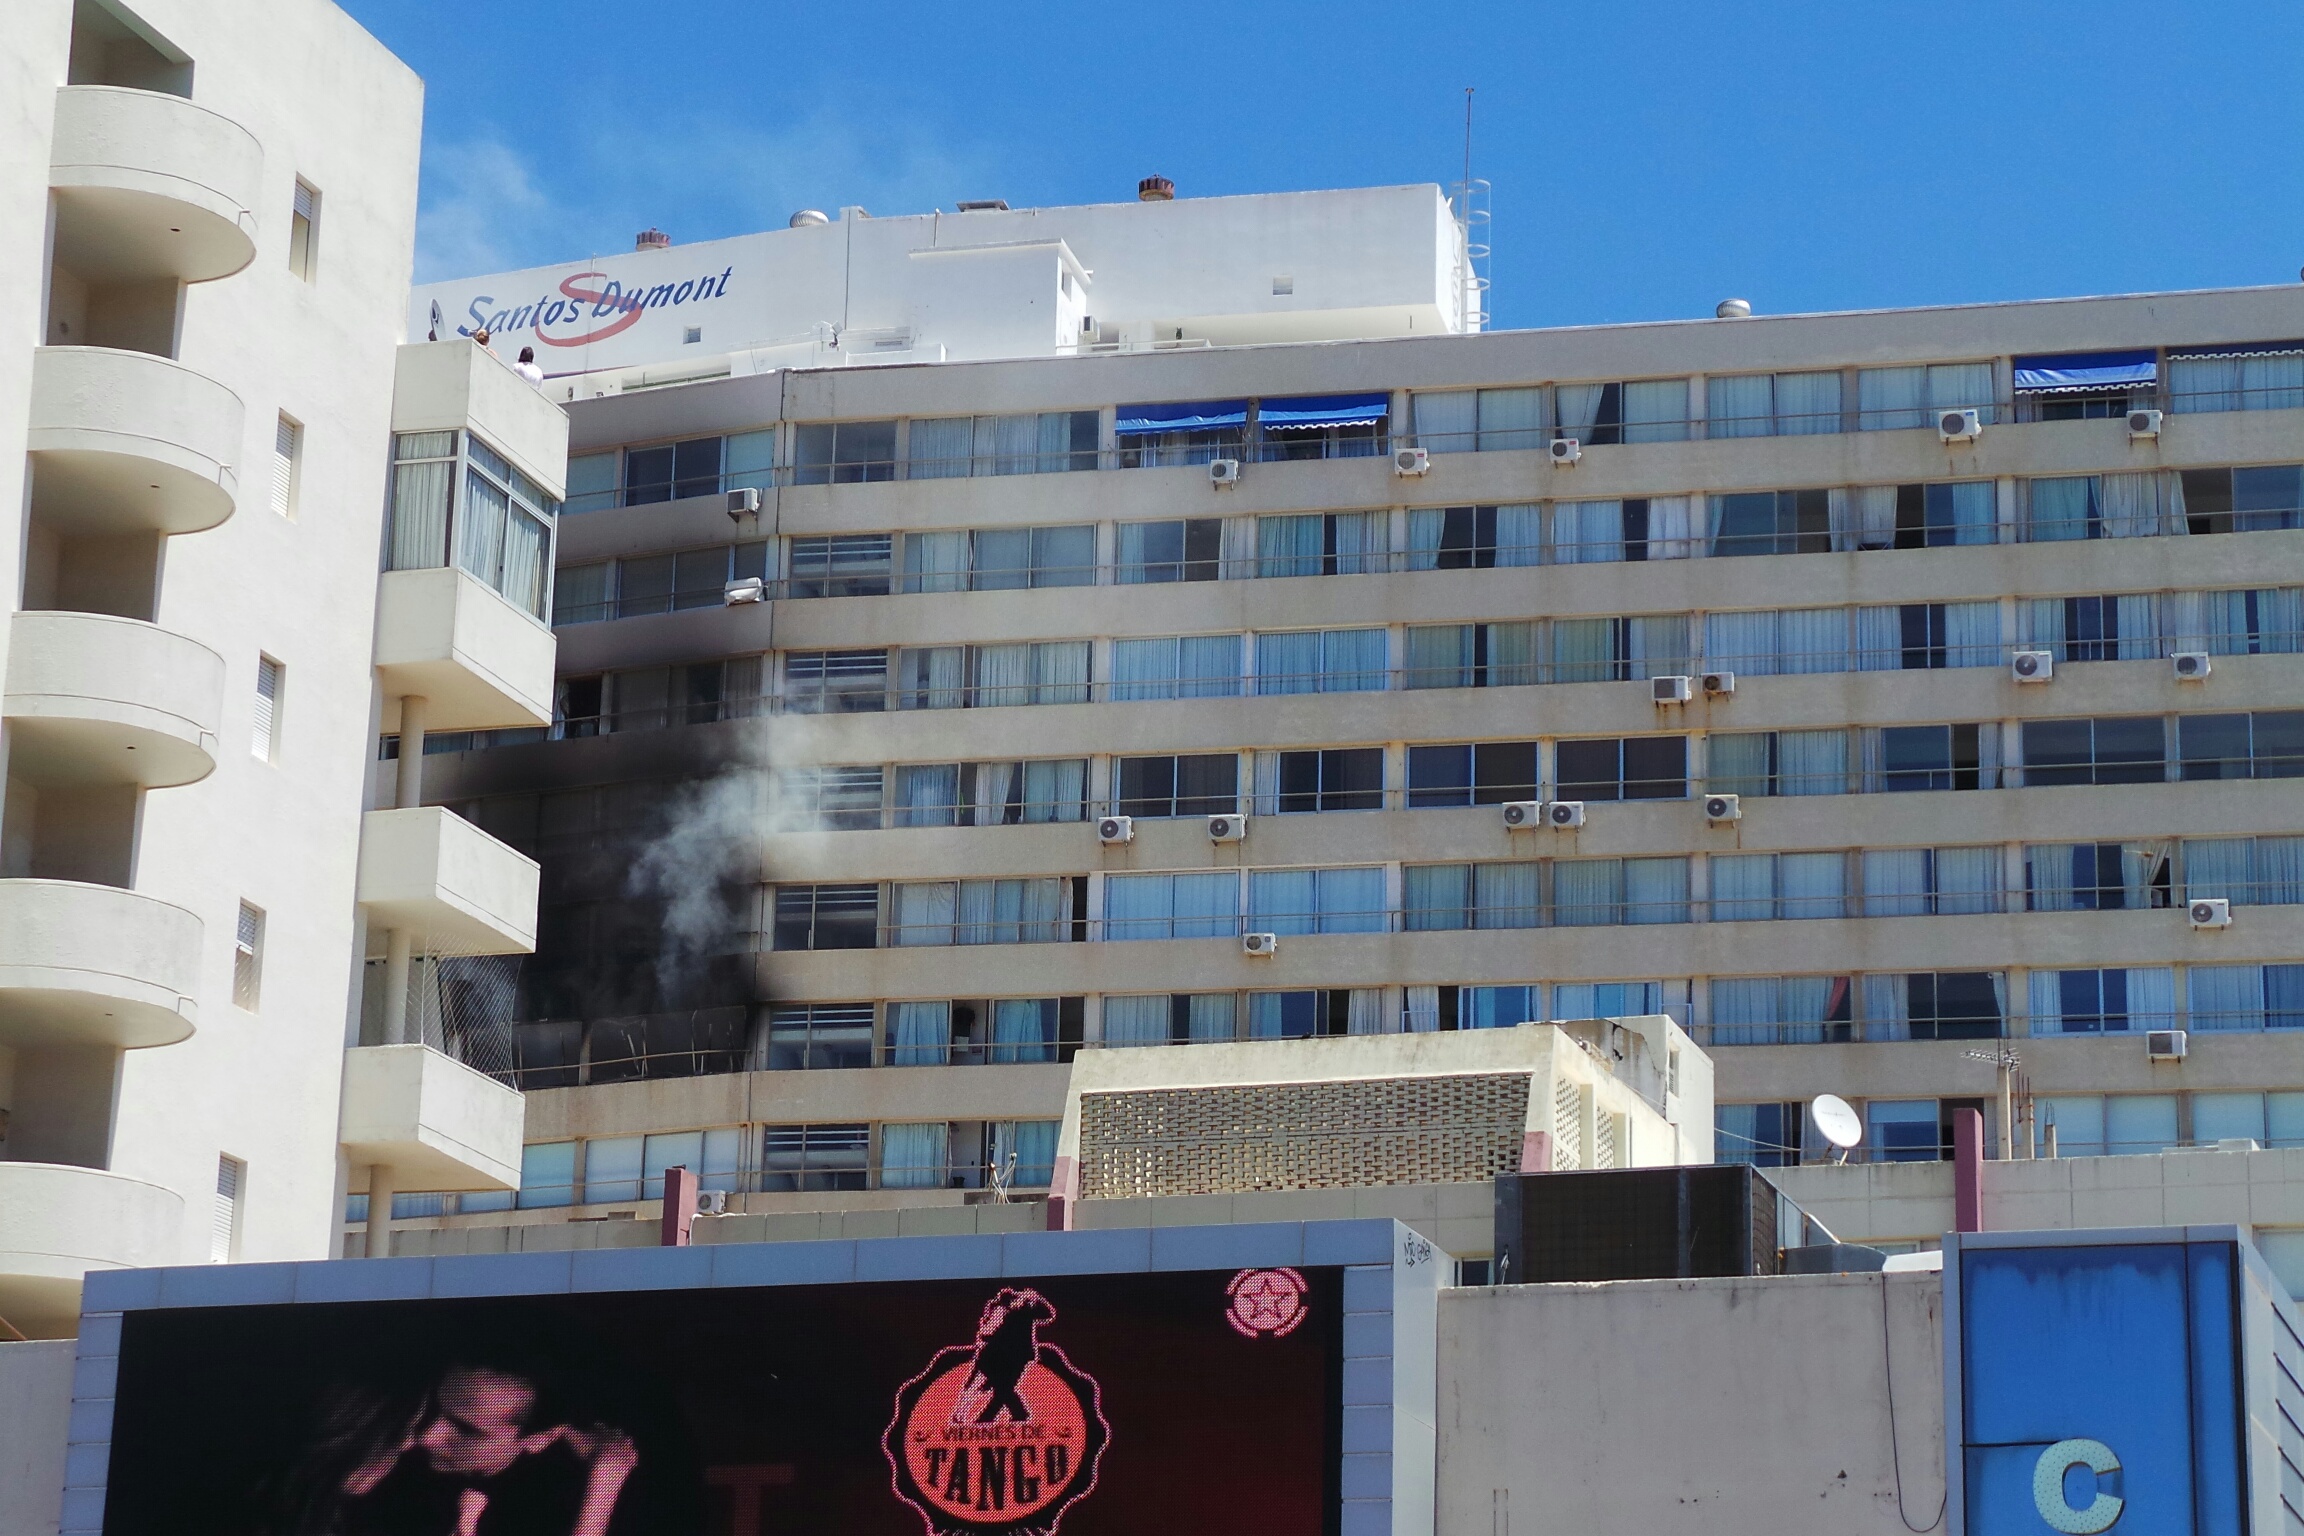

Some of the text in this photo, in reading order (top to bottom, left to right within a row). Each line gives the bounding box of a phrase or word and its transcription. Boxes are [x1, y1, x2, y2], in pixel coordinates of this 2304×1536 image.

[456, 266, 733, 337] Santos Dumont
[942, 1424, 1045, 1441] VIERNES DE
[924, 1444, 1069, 1512] TANGO
[2032, 1438, 2125, 1536] C
